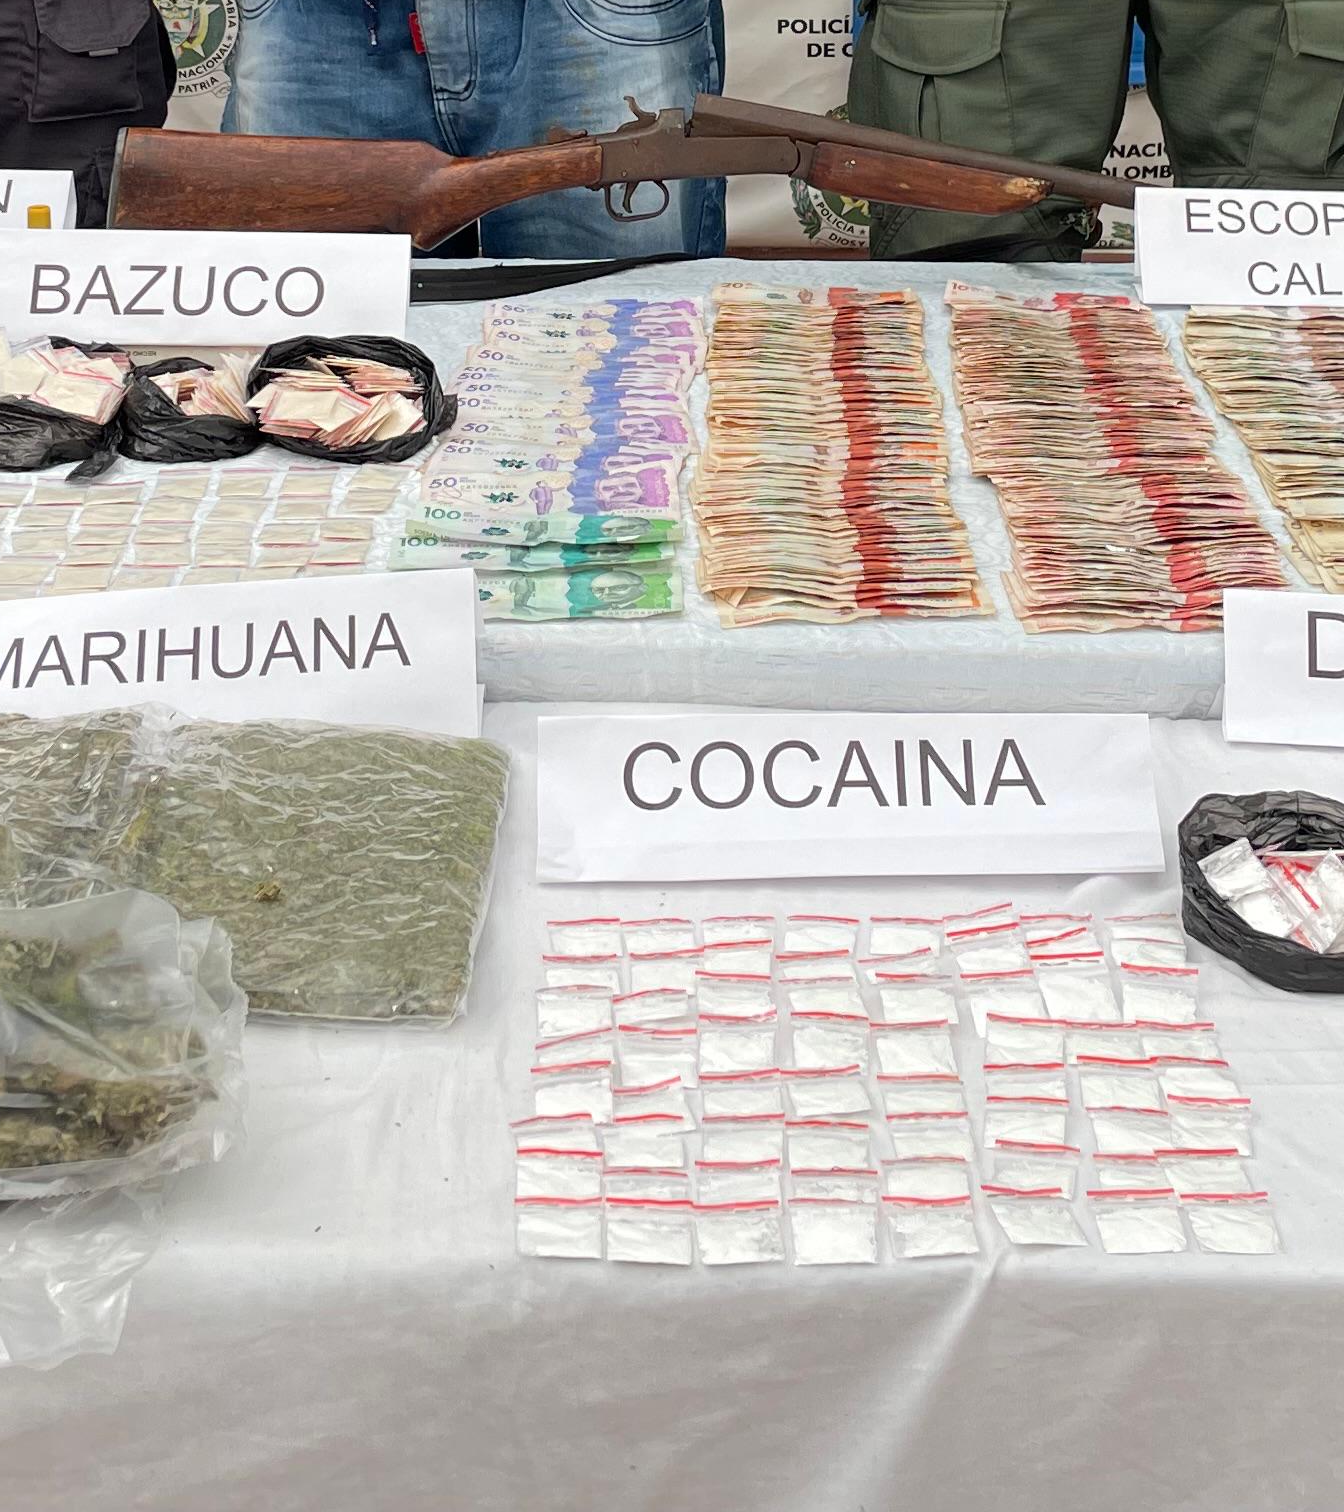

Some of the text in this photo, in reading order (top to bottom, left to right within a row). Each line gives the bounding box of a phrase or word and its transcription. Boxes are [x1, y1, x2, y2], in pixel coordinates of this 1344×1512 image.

[777, 14, 853, 35] POLICÍ
[807, 43, 836, 58] DE
[178, 43, 232, 79] NACIONAL
[178, 76, 220, 94] PATRIA
[1110, 142, 1163, 159] NACI
[1246, 259, 1344, 297] CAL
[28, 263, 324, 317] BAZUCO
[478, 349, 504, 361] 50
[460, 423, 489, 433] 50
[443, 444, 472, 454] 50
[428, 477, 457, 488] 50
[423, 507, 462, 520] 100
[399, 536, 439, 547] 100
[622, 738, 1046, 811] COCAINA
